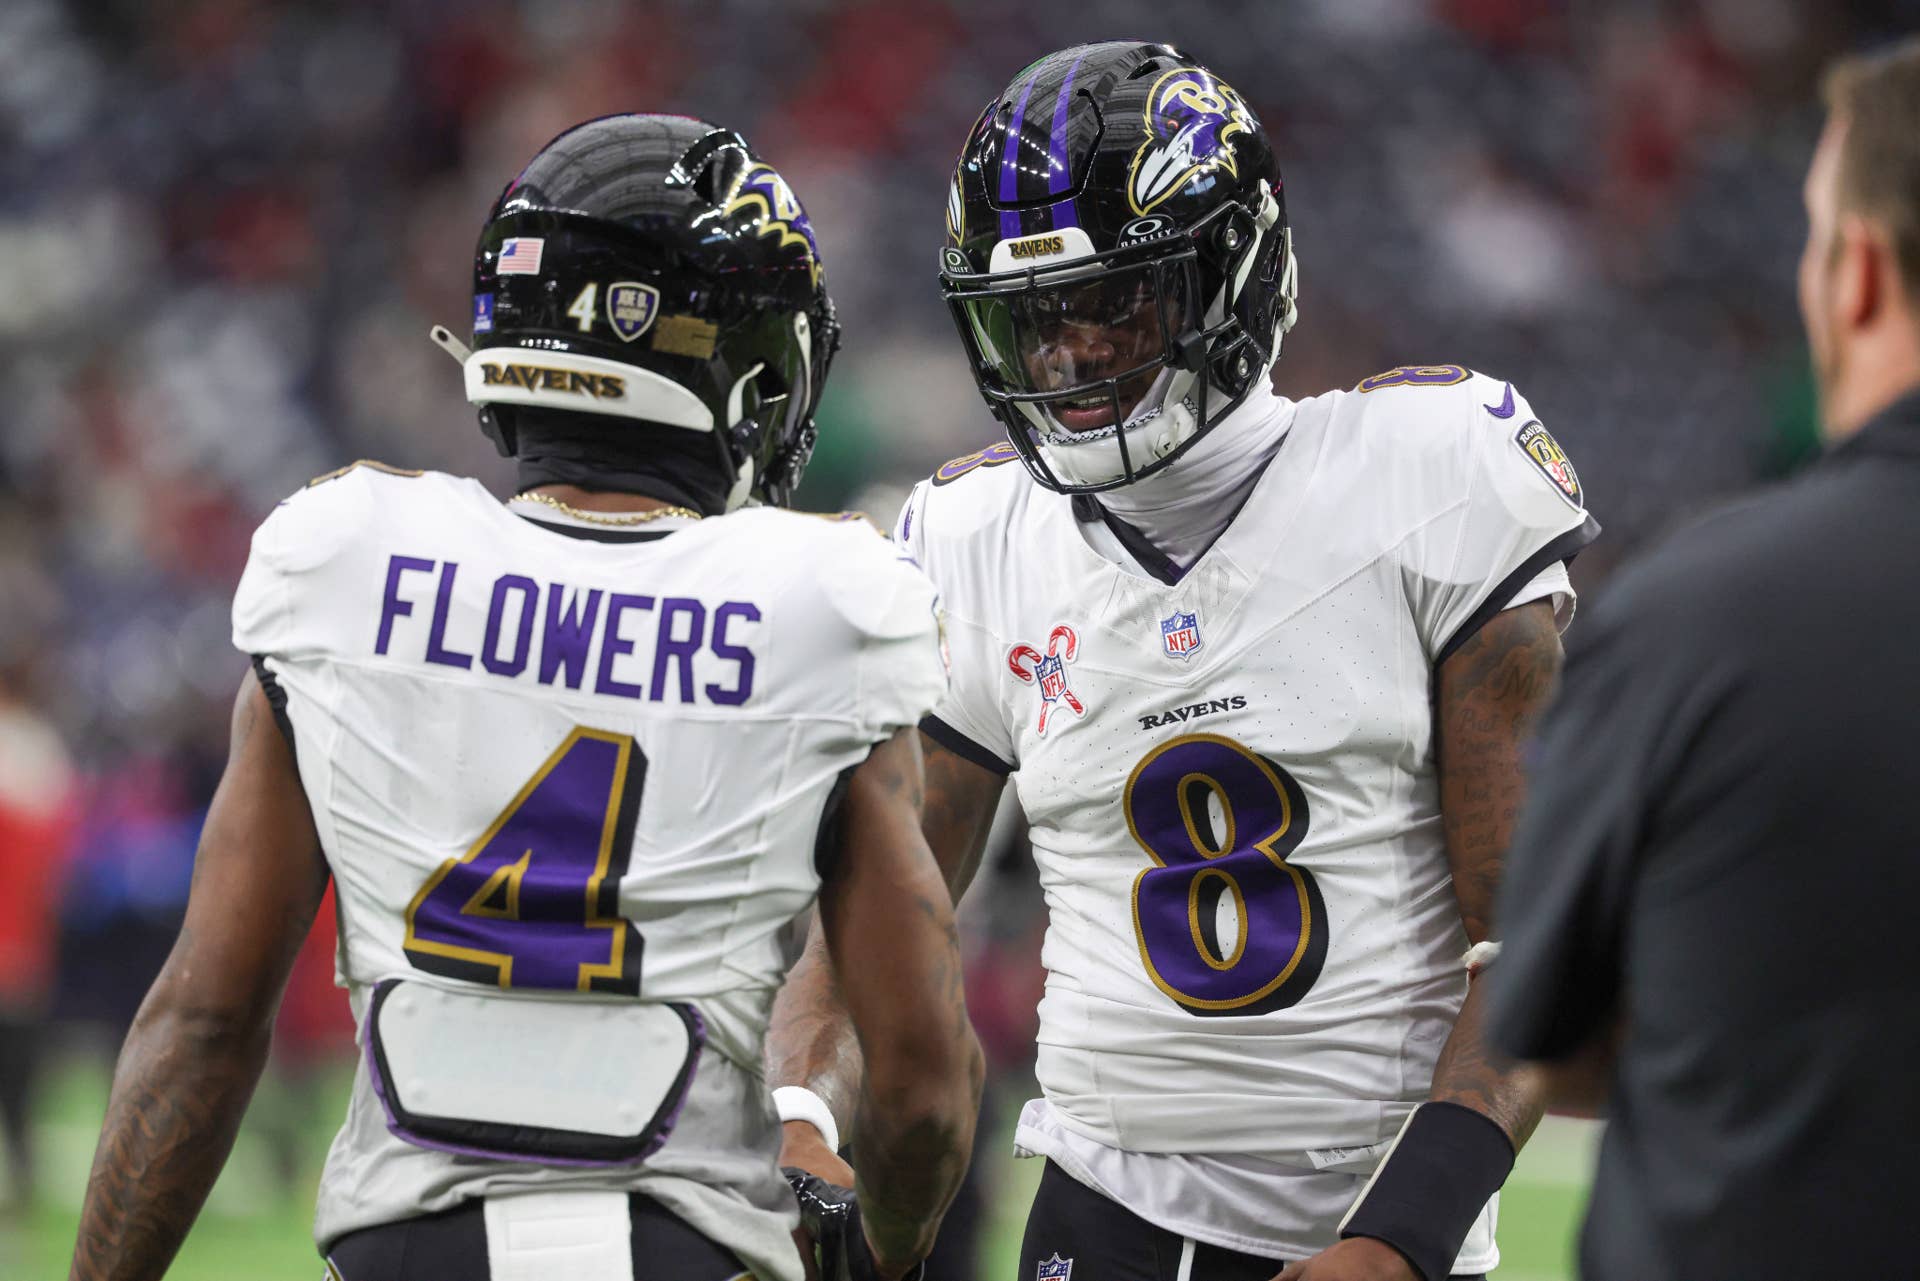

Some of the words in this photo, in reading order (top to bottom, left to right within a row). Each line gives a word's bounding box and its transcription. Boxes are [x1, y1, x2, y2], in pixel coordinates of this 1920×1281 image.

[1008, 235, 1065, 259] RAVENS
[567, 282, 598, 333] 4
[480, 361, 626, 399] RAVENS
[1359, 365, 1473, 393] 8
[1519, 424, 1546, 446] RAVE
[374, 554, 762, 707] FLOWERS
[1166, 628, 1197, 652] NFL
[1042, 671, 1066, 698] NFL
[1138, 695, 1247, 731] RAVENS
[402, 724, 649, 995] 4
[1123, 732, 1330, 1018] 8
